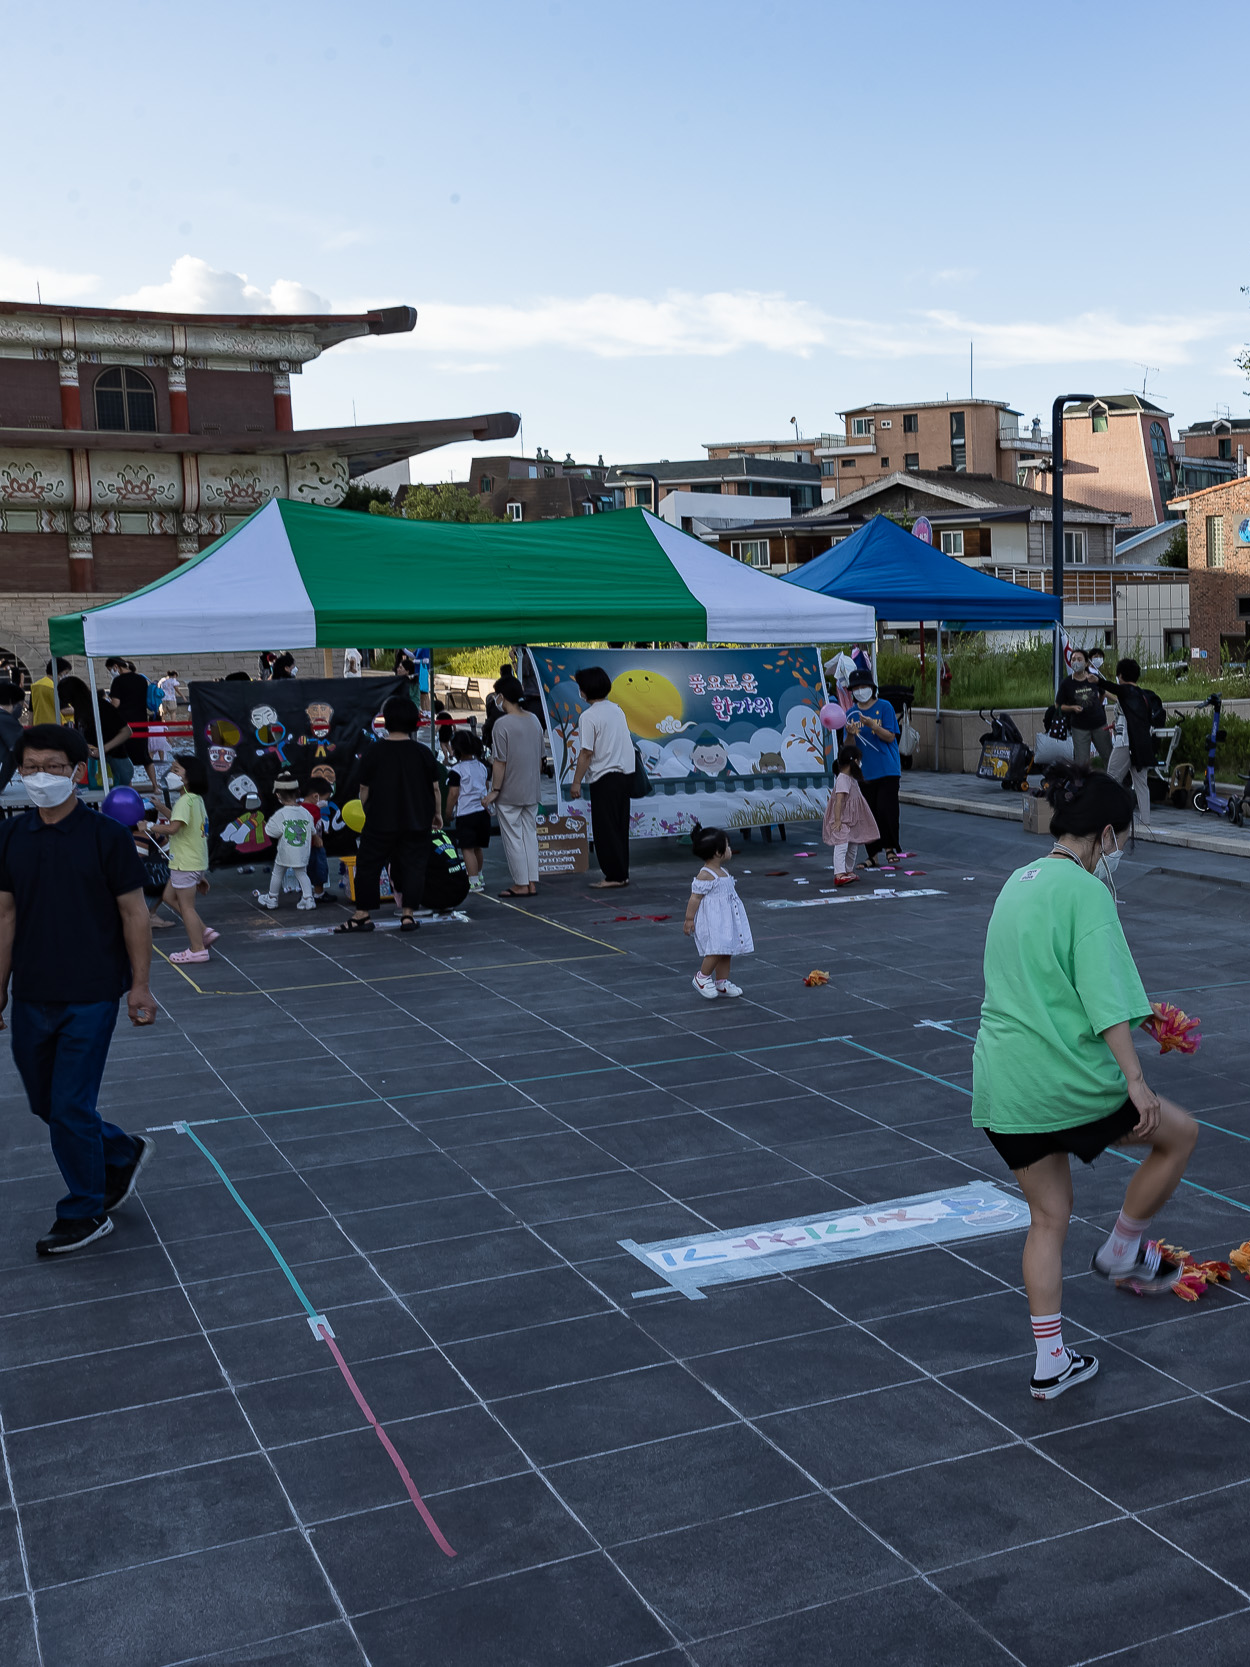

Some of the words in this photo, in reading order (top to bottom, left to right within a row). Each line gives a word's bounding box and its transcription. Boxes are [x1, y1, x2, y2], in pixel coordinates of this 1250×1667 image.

[688, 672, 759, 695] 풍요로운
[711, 695, 774, 722] 한가위
[662, 1209, 934, 1266] 제기차기
